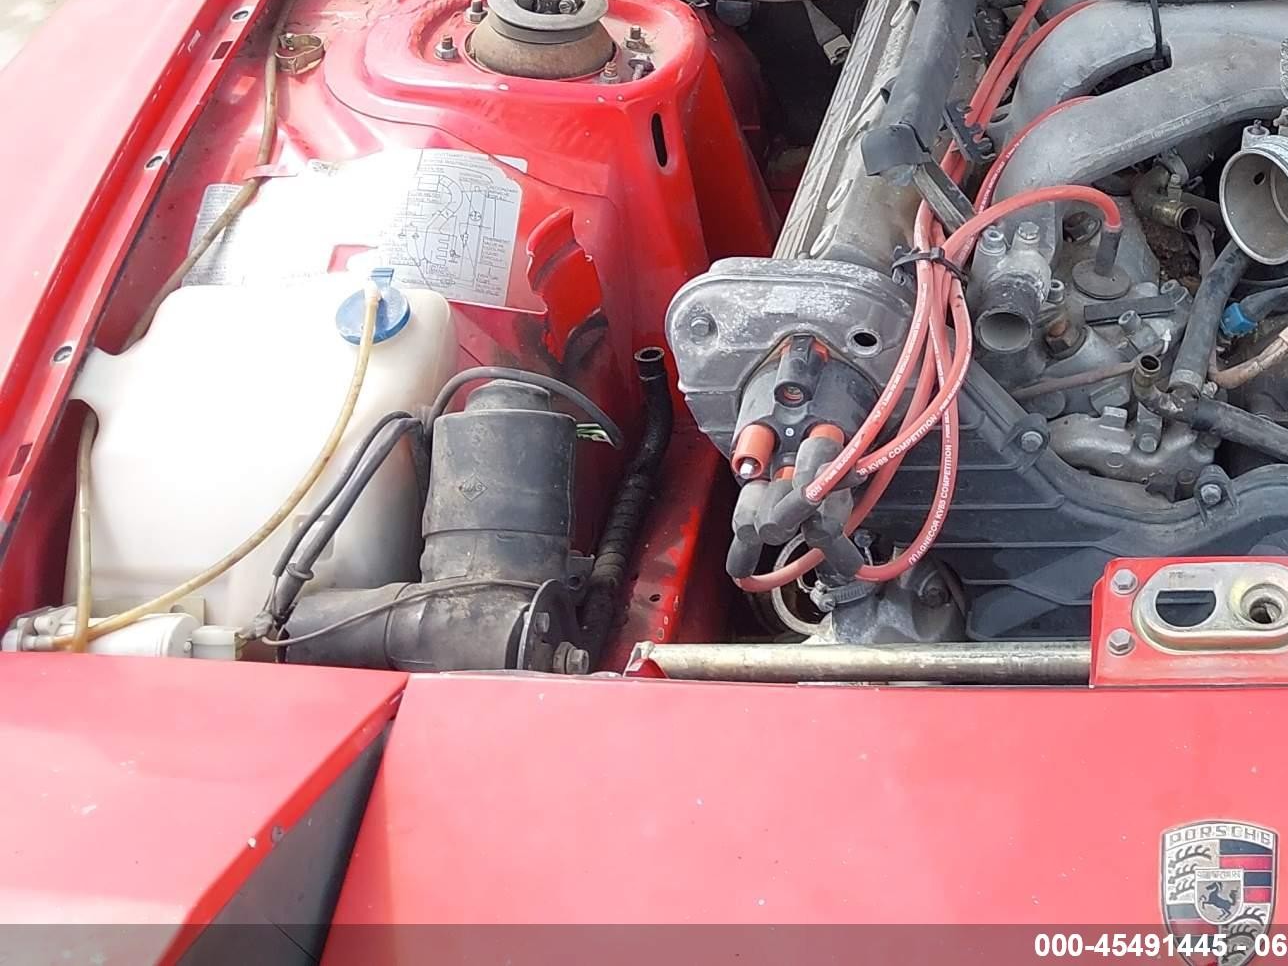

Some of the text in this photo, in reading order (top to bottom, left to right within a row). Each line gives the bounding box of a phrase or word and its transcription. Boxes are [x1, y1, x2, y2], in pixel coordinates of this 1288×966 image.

[888, 414, 938, 459] COMPETITION
[940, 444, 953, 499] COMPETITION
[1168, 825, 1272, 846] PORSCHE
